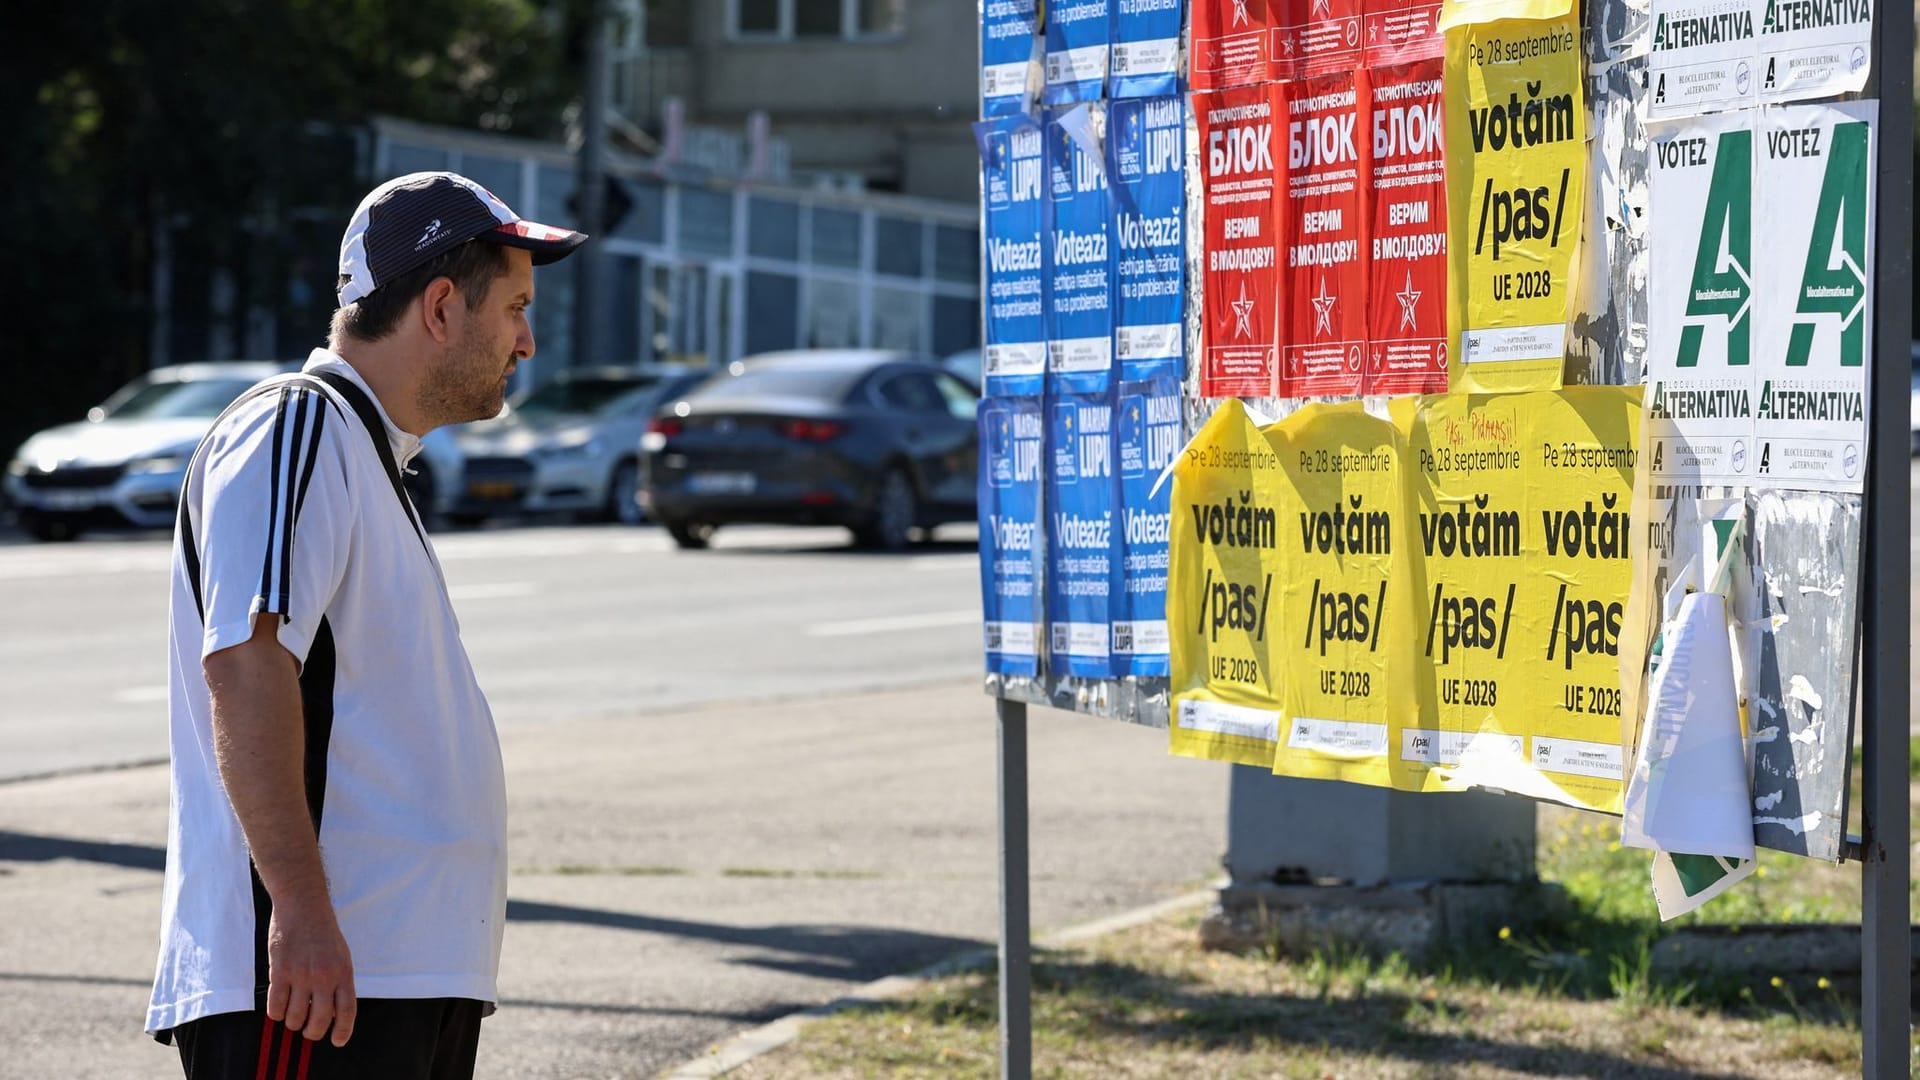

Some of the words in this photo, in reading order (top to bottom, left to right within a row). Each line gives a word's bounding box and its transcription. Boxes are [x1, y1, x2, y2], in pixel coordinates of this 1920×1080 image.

[1666, 8, 1696, 20] BLOCUL
[1762, 0, 1870, 34] ALTERNATIVA
[1652, 10, 1754, 52] ALTERNATIVA
[1470, 43, 1484, 68] Pe
[1487, 39, 1501, 65] 28
[1506, 26, 1573, 66] septembrie
[1809, 55, 1839, 66] ELECTORAL
[1656, 73, 1665, 103] A
[1698, 71, 1726, 82] ELECTORAL
[1765, 57, 1775, 88] A
[1145, 100, 1181, 130] MARIAN
[1289, 87, 1356, 115] ПАТРИОТИЧЕСКИЙ
[1469, 80, 1573, 152] votăm
[1289, 112, 1357, 170] БЛОК
[1373, 101, 1442, 160] БЛОК
[1768, 128, 1820, 159] VOTEZ
[1146, 127, 1181, 175] LUPU
[1209, 124, 1273, 177] БЛОК
[1657, 138, 1707, 169] VOTEZ
[1012, 157, 1041, 202] LUPU
[1117, 207, 1180, 250] Votează
[1224, 216, 1259, 240] ВЕРИМ
[1304, 209, 1342, 234] ВЕРИМ
[1389, 201, 1428, 226] ВЕРИМ
[1475, 168, 1570, 261] /pas/
[1211, 251, 1217, 271] В
[1219, 246, 1274, 272] МОЛДОВУ!
[1290, 246, 1297, 267] В
[1298, 240, 1357, 268] МОЛДОВУ!
[1373, 240, 1380, 260] В
[1381, 233, 1446, 261] МОЛДОВУ!
[1054, 272, 1075, 293] echipa
[1119, 256, 1144, 278] echipa
[1121, 284, 1130, 298] nu
[1132, 283, 1137, 297] a
[1493, 273, 1511, 301] UE
[1516, 270, 1551, 300] 2028
[1054, 299, 1063, 312] nu
[1064, 298, 1069, 312] a
[1650, 381, 1750, 419] ALTERNATIVA
[1664, 380, 1694, 389] BLOCUL
[1147, 395, 1178, 425] MARIAN
[1757, 380, 1863, 421] ALTERNATIVA
[1080, 434, 1111, 478] LUPU
[1187, 449, 1207, 468] Pe
[1209, 446, 1221, 468] 28
[1223, 446, 1276, 474] septembrie
[1300, 451, 1312, 473] Pe
[1315, 450, 1328, 473] 28
[1331, 448, 1390, 477] septembrie
[1420, 449, 1434, 473] Pe
[1437, 448, 1451, 472] 28
[1455, 444, 1520, 477] septembrie
[1544, 443, 1558, 467] Pe
[1562, 443, 1577, 467] 28
[1581, 443, 1638, 474] septembr
[1652, 441, 1663, 471] A
[1694, 446, 1722, 454] ELECTORAL
[1759, 442, 1769, 473] A
[1803, 448, 1833, 459] ELECTORAL
[990, 515, 1035, 551] Voteaz
[1122, 507, 1170, 545] Voteaz
[1192, 490, 1276, 549] votăm
[1300, 494, 1390, 555] votăm
[1420, 493, 1520, 558] votăm
[1124, 550, 1146, 574] echipa
[1124, 579, 1135, 593] nu
[1135, 578, 1140, 593] a
[1198, 568, 1272, 643] /pas/
[1305, 579, 1387, 656] /pas/
[1425, 583, 1516, 665] /pas/
[1547, 584, 1623, 669] /pas
[1212, 656, 1226, 680] UE
[1230, 658, 1257, 684] 2028
[1321, 670, 1335, 695] UE
[1341, 671, 1370, 697] 2028
[1442, 679, 1459, 705] UE
[1464, 679, 1497, 707] 2028
[1565, 685, 1583, 712] UE
[1588, 687, 1621, 717] 2028
